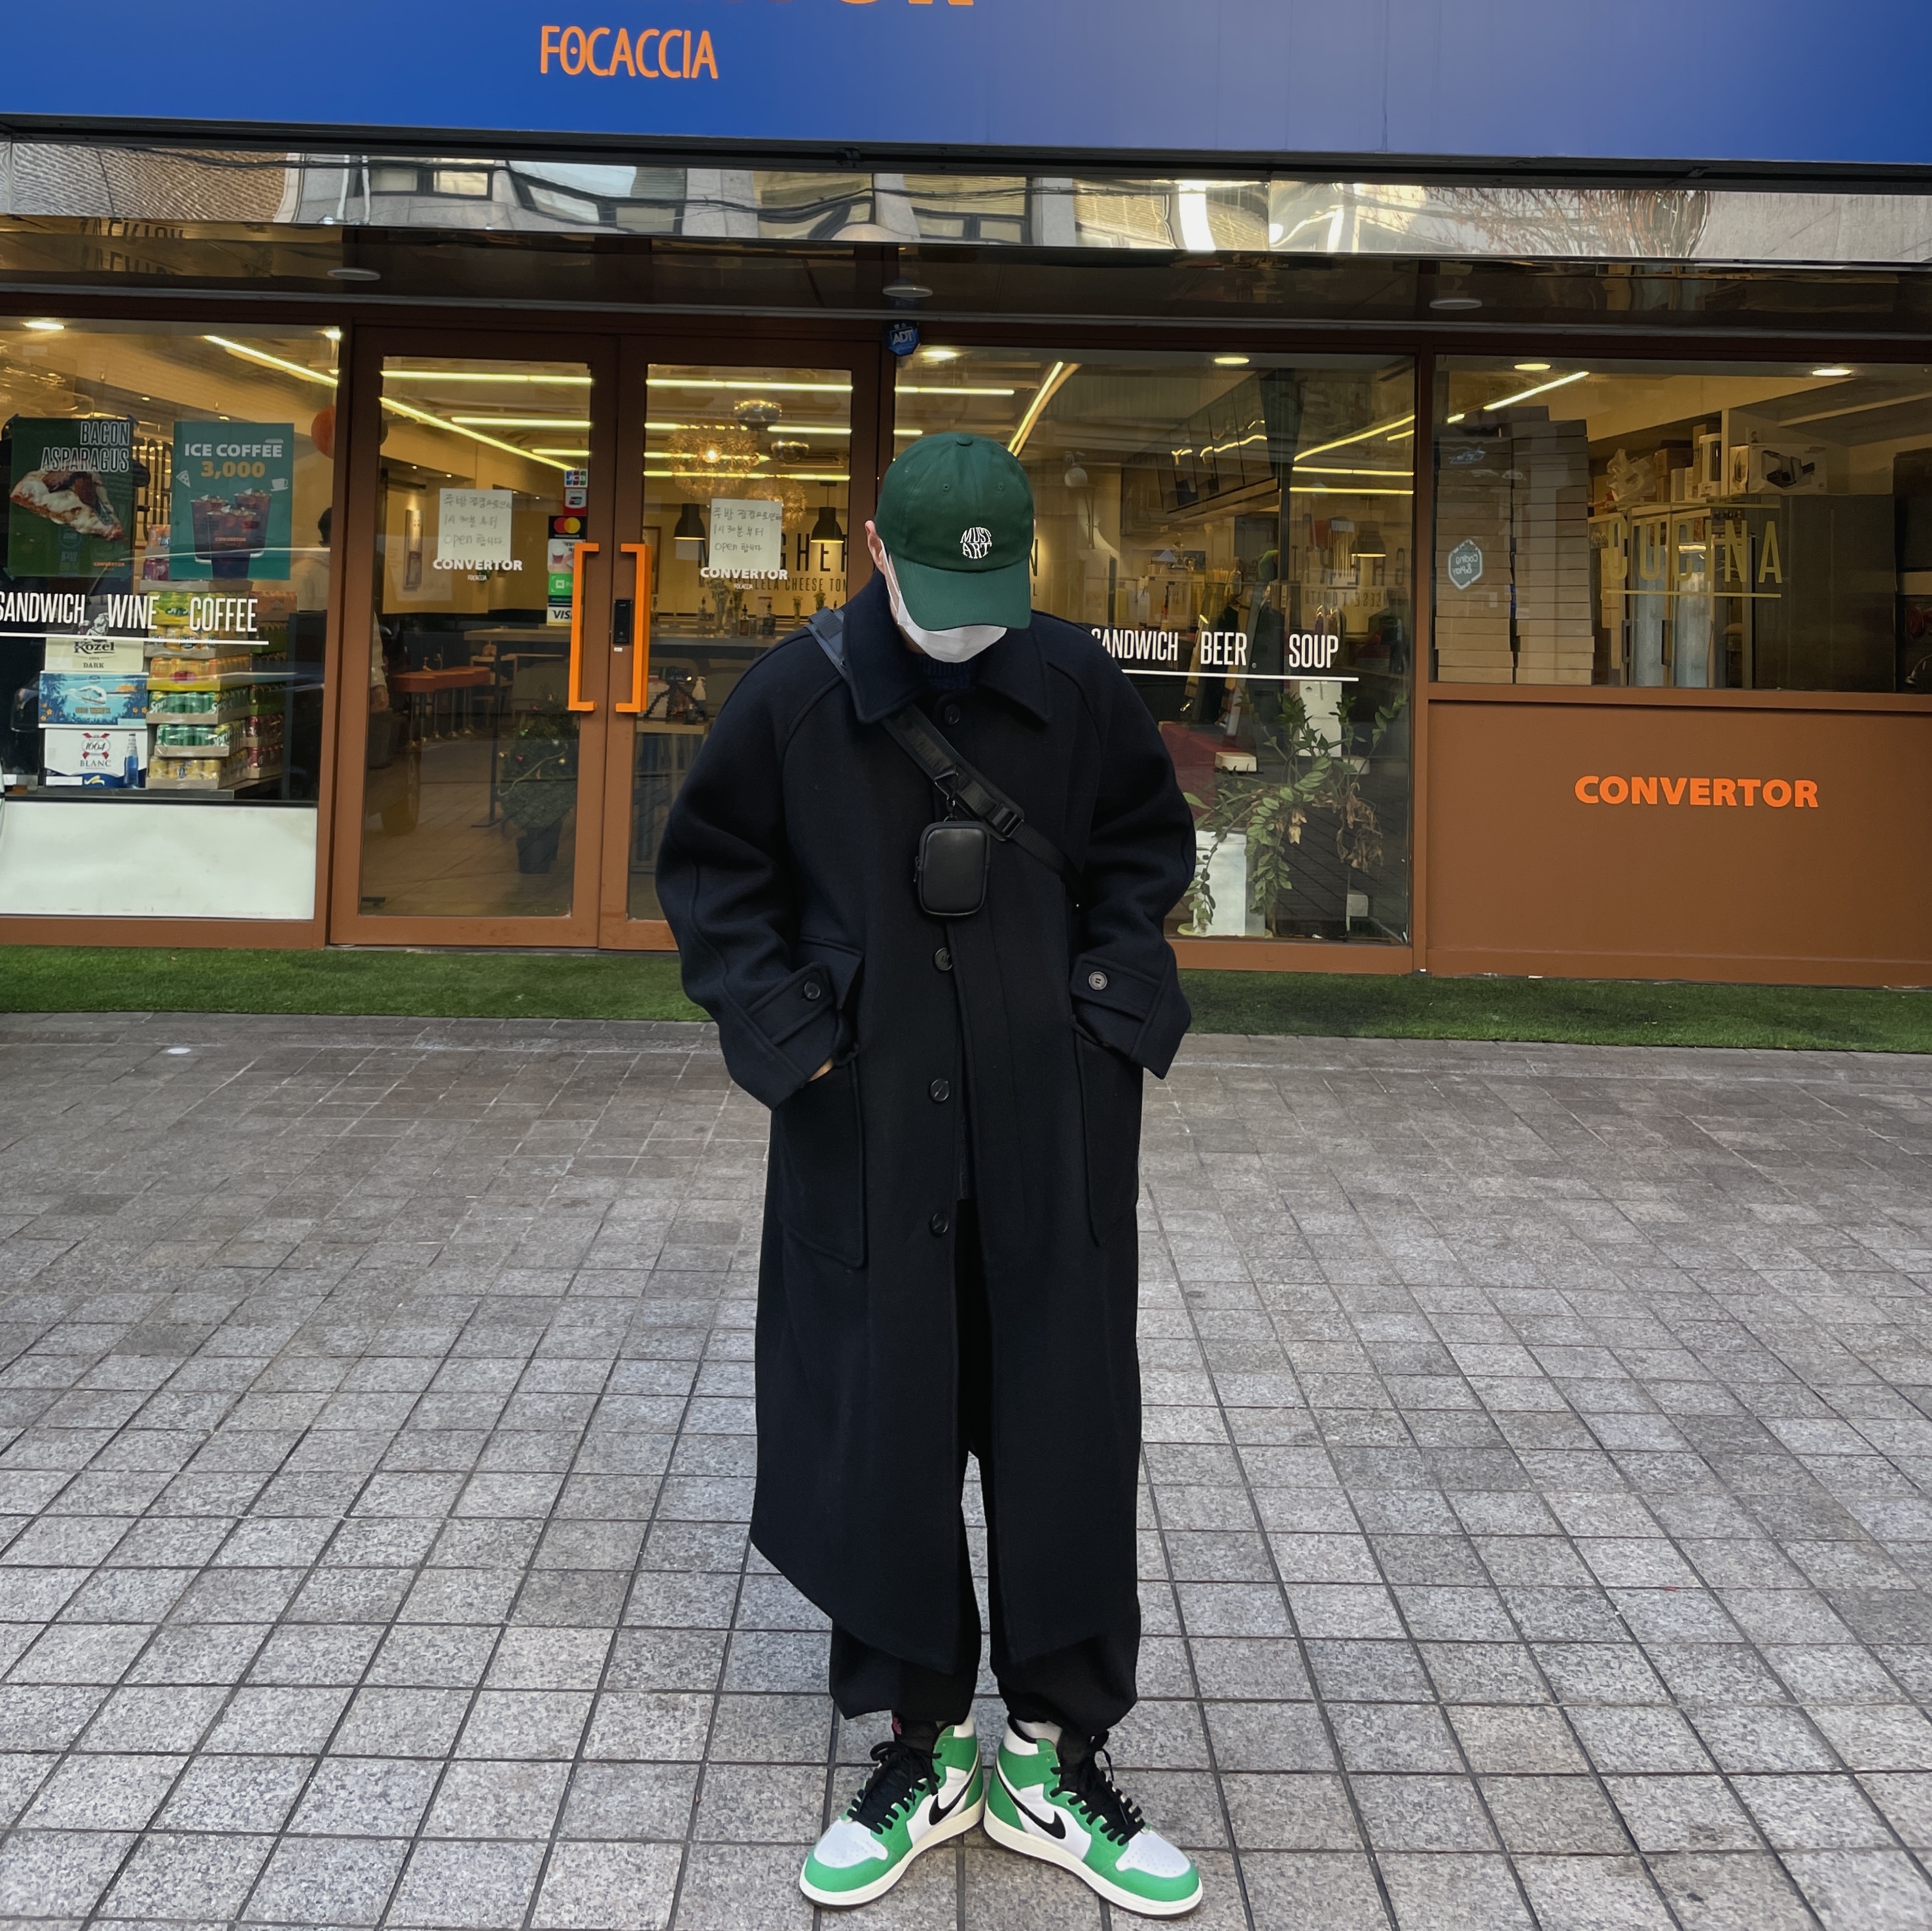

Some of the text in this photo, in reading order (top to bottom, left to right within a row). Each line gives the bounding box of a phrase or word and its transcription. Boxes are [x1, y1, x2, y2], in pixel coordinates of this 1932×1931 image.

[540, 26, 719, 79] FOCACCIA
[892, 329, 914, 345] ADT
[80, 421, 130, 446] BACON
[40, 447, 130, 472] ASPARAGUS
[185, 444, 282, 457] ICE COFFEE
[200, 460, 266, 480] 3,000
[959, 526, 992, 544] MUST
[962, 542, 993, 559] ART
[1607, 517, 1782, 584] CUCINA
[433, 558, 523, 571] CONVERTOR
[700, 567, 788, 580] CONVERTOR
[107, 593, 160, 629] WINE
[189, 597, 259, 633] COFFEE
[552, 610, 573, 620] VIS
[74, 641, 115, 654] Kozel
[1200, 631, 1247, 666] BEER
[1289, 633, 1338, 669] SOUP
[1574, 775, 1819, 807] CONVERTOR
